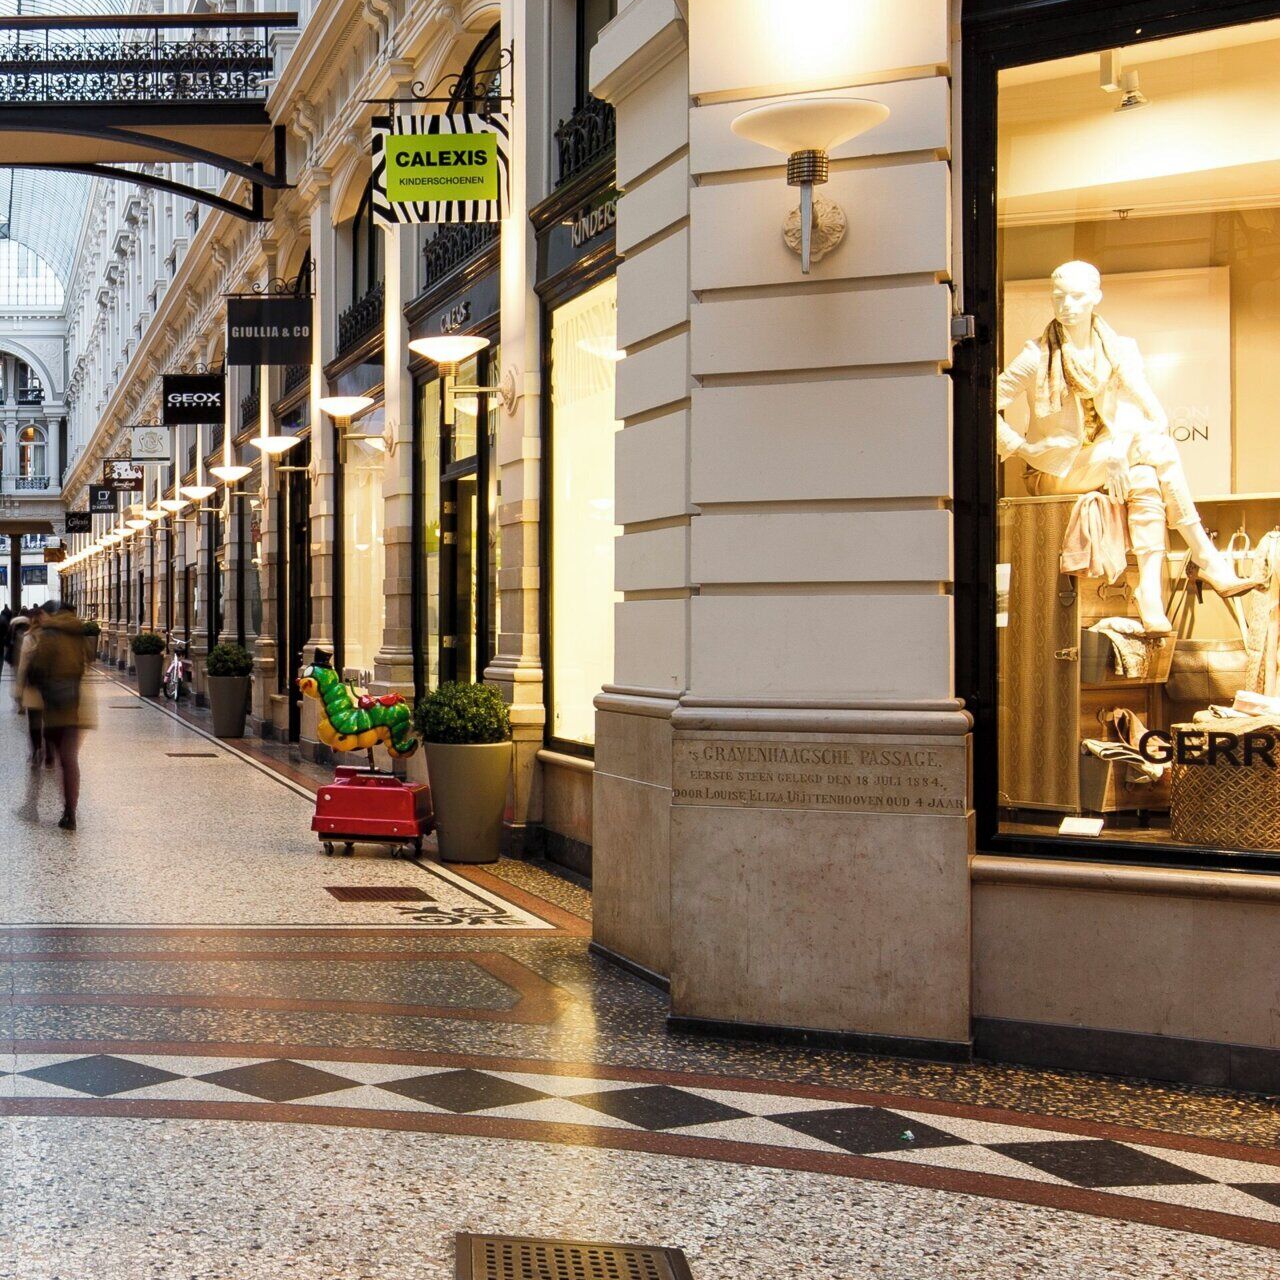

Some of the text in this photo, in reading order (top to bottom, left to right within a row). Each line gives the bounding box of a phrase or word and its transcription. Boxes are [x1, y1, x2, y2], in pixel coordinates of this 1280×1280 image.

[395, 149, 488, 168] CALEXIS
[399, 176, 484, 186] KINDERSCHOENEN
[231, 326, 310, 338] GIULLIA & CO
[167, 392, 221, 403] GEOX
[690, 770, 733, 781] EERSTE
[737, 771, 774, 782] STEEN
[777, 773, 822, 783] GELEGD
[827, 774, 851, 785] DEN
[857, 775, 869, 786] 18
[873, 776, 901, 786] JULI
[673, 788, 703, 798] DOOR
[886, 796, 910, 807] OUD
[914, 797, 924, 807] 4
[927, 798, 964, 809] JAAR
